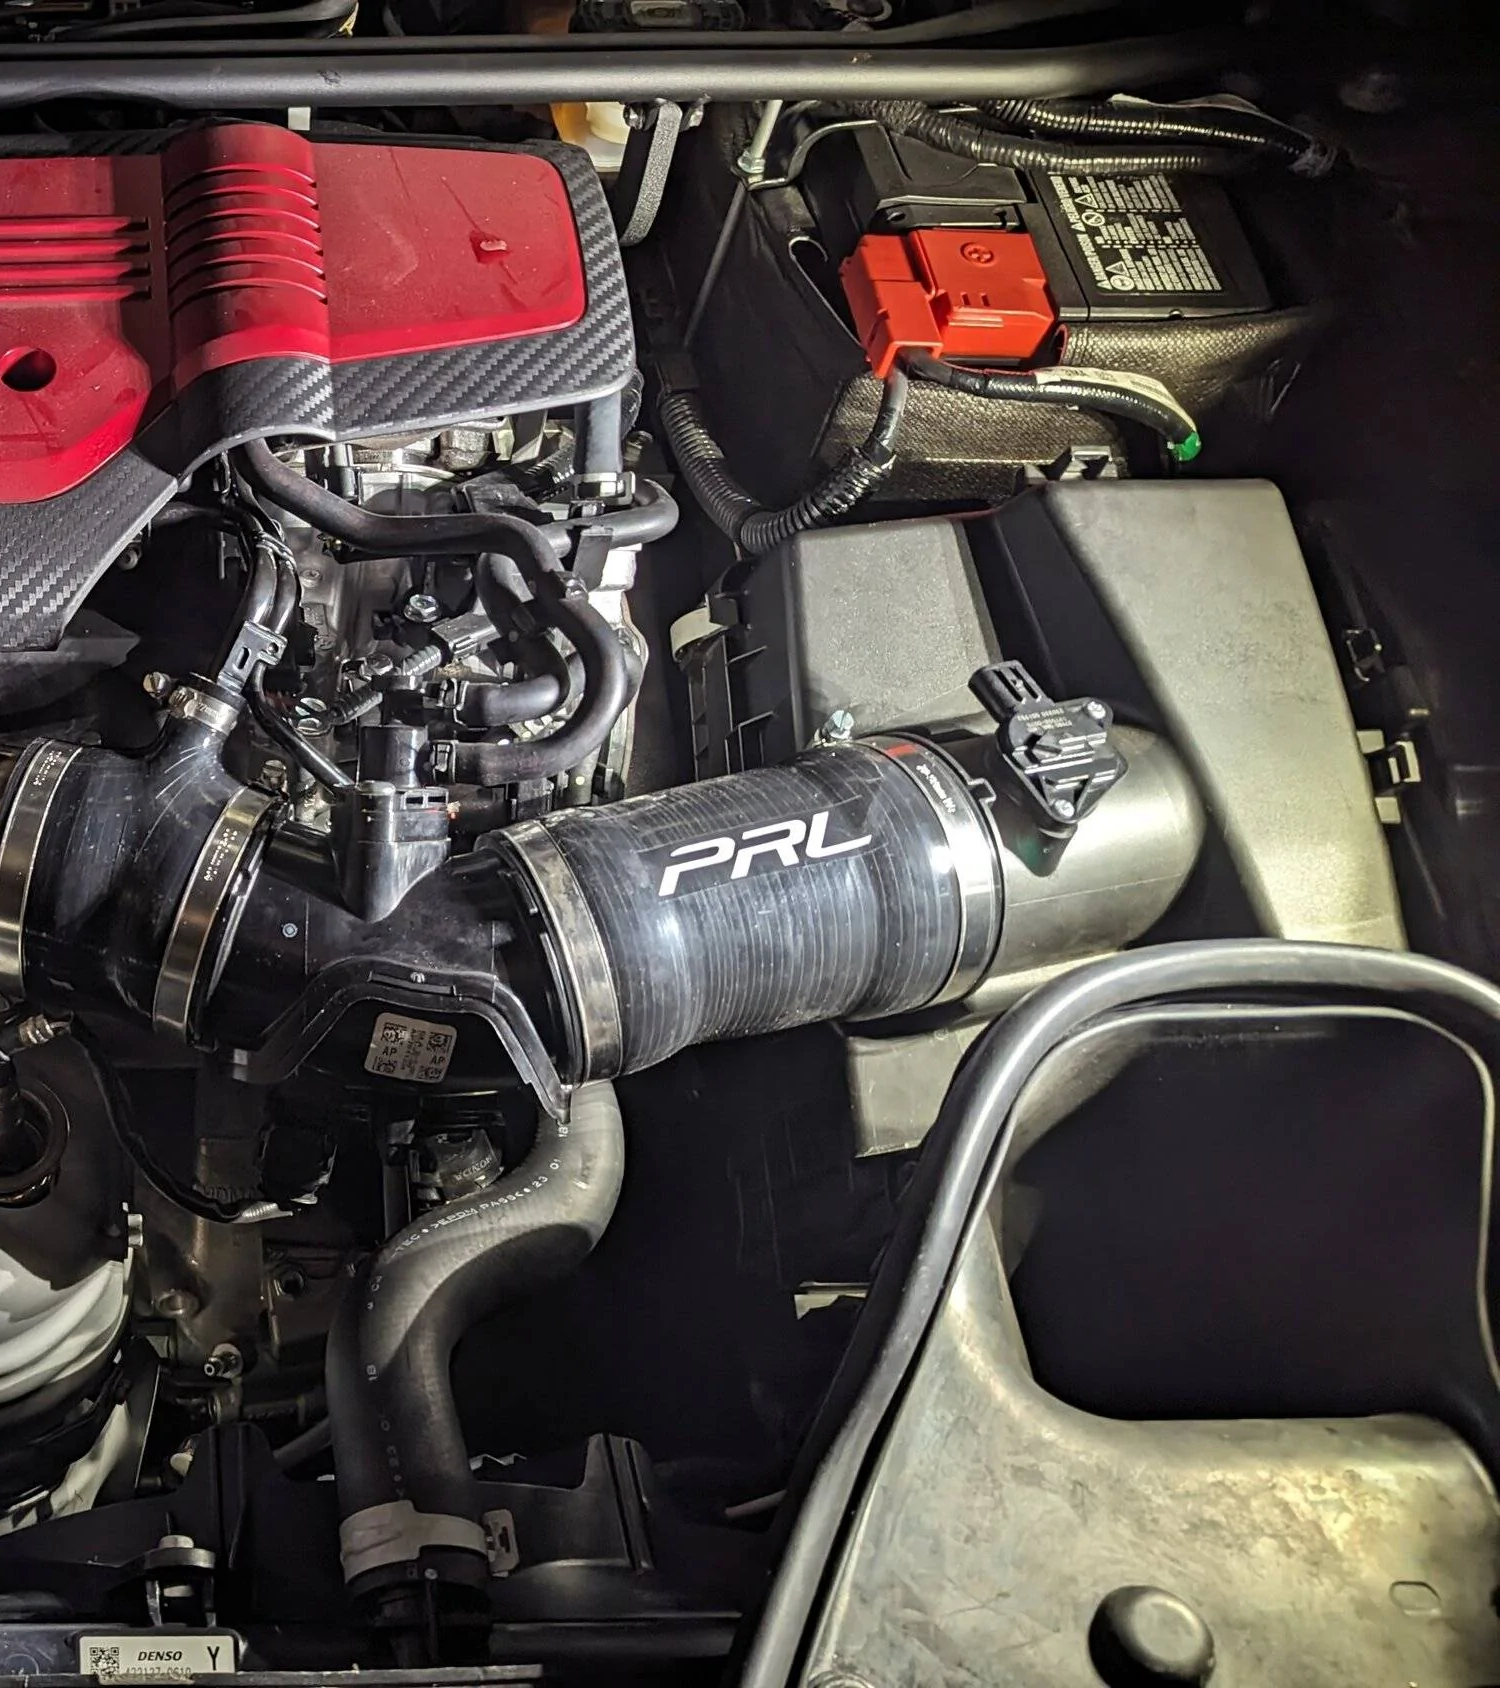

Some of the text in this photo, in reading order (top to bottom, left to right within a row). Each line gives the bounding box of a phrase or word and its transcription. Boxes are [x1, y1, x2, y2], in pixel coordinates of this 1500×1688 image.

[658, 811, 873, 897] PRL
[382, 1046, 397, 1056] AP
[431, 1055, 446, 1065] AP
[532, 1176, 549, 1188] 23
[557, 1126, 569, 1138] 18
[137, 1645, 220, 1672] DENSO Y
